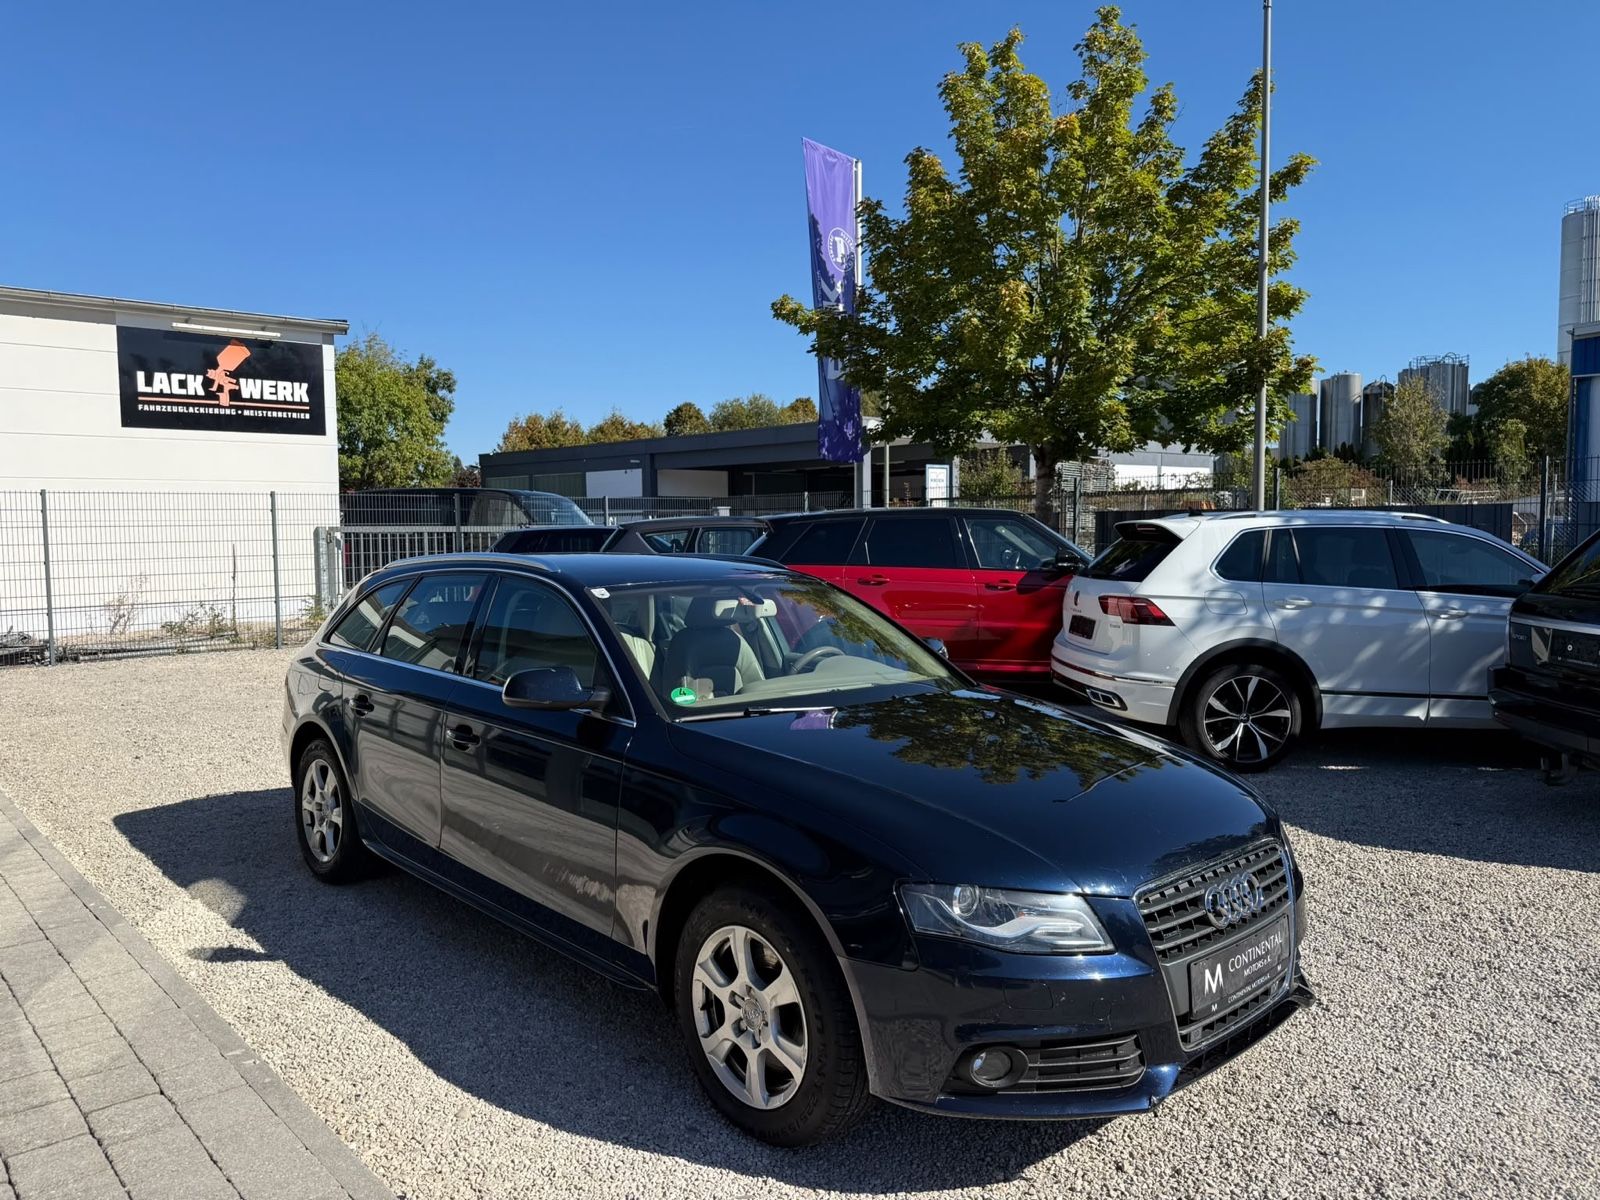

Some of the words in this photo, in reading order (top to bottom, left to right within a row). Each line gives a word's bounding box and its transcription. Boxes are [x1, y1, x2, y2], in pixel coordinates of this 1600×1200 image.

[137, 371, 205, 396] LACK
[238, 378, 310, 402] WERK
[137, 404, 236, 415] FAHRZEUGLACKIERUNG
[243, 409, 310, 420] MEISTERBETRIEB
[1229, 932, 1282, 972] CONTINENTAL
[1244, 959, 1263, 976] MOTORS
